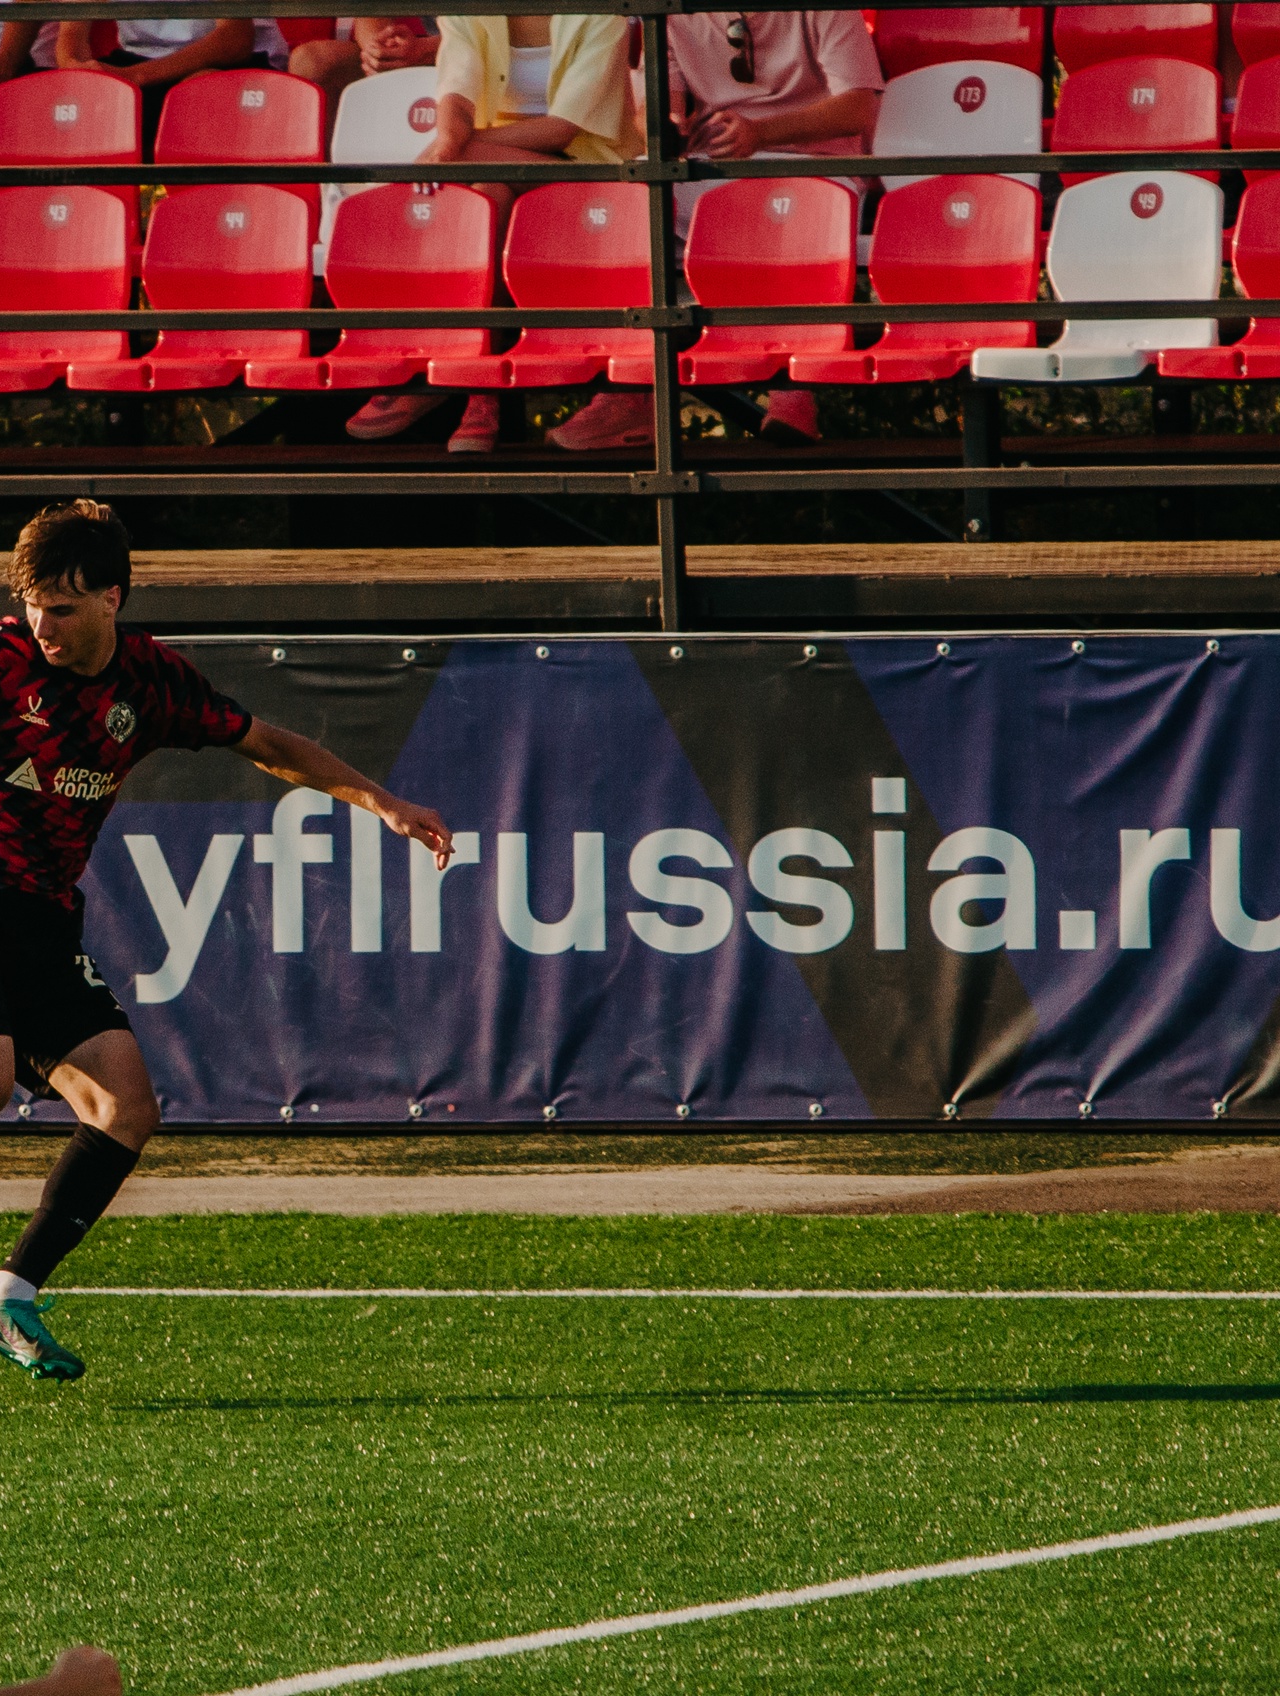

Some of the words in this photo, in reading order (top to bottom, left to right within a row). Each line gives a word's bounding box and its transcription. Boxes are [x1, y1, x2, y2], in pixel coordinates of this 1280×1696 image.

[242, 90, 265, 107] 169
[960, 87, 980, 103] 173
[1132, 88, 1155, 105] 174
[55, 104, 78, 121] 168
[413, 107, 436, 123] 170
[772, 197, 791, 214] 47
[1138, 193, 1157, 210] 49
[48, 204, 67, 222] 43
[412, 204, 431, 221] 45
[588, 208, 607, 225] 46
[951, 202, 970, 219] 48
[225, 212, 245, 229] 44
[53, 766, 114, 785] АКРОН
[124, 777, 1280, 1004] yflrussia.ru
